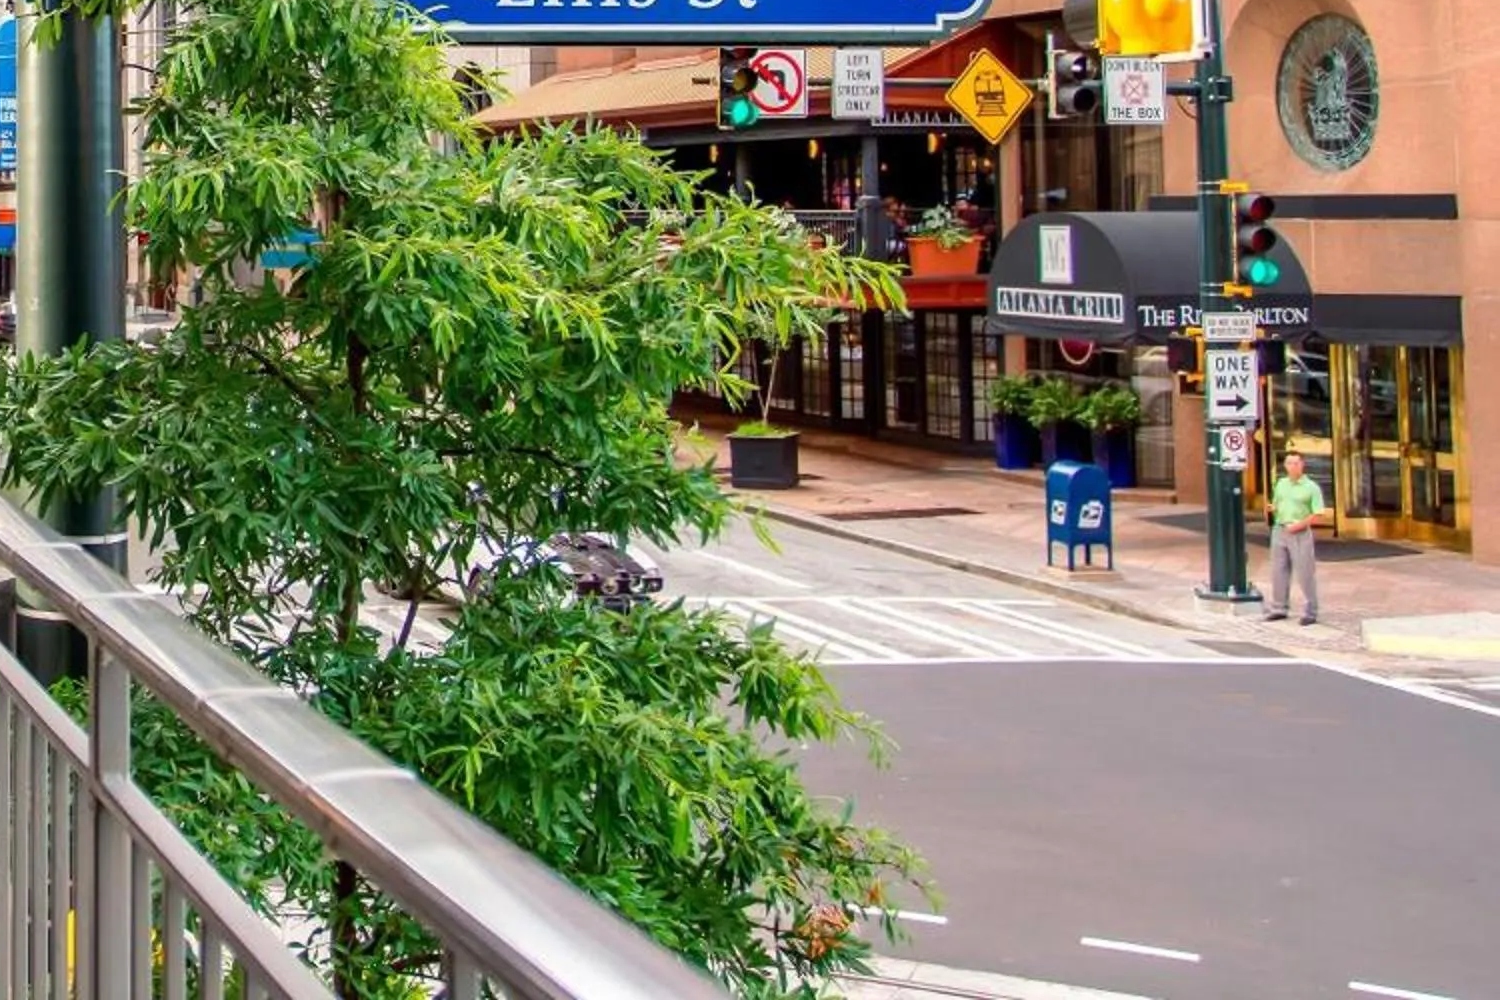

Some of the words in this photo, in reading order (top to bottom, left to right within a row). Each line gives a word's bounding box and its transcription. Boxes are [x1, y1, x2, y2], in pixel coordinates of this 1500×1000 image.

[846, 70, 871, 80] TURN
[845, 100, 871, 111] ONLY
[1111, 107, 1133, 119] THE
[1137, 107, 1161, 119] BOX
[1000, 290, 1065, 316] ATLANTA
[1073, 295, 1121, 320] GRILL
[1214, 356, 1251, 371] ONE
[1214, 375, 1250, 390] WAY
